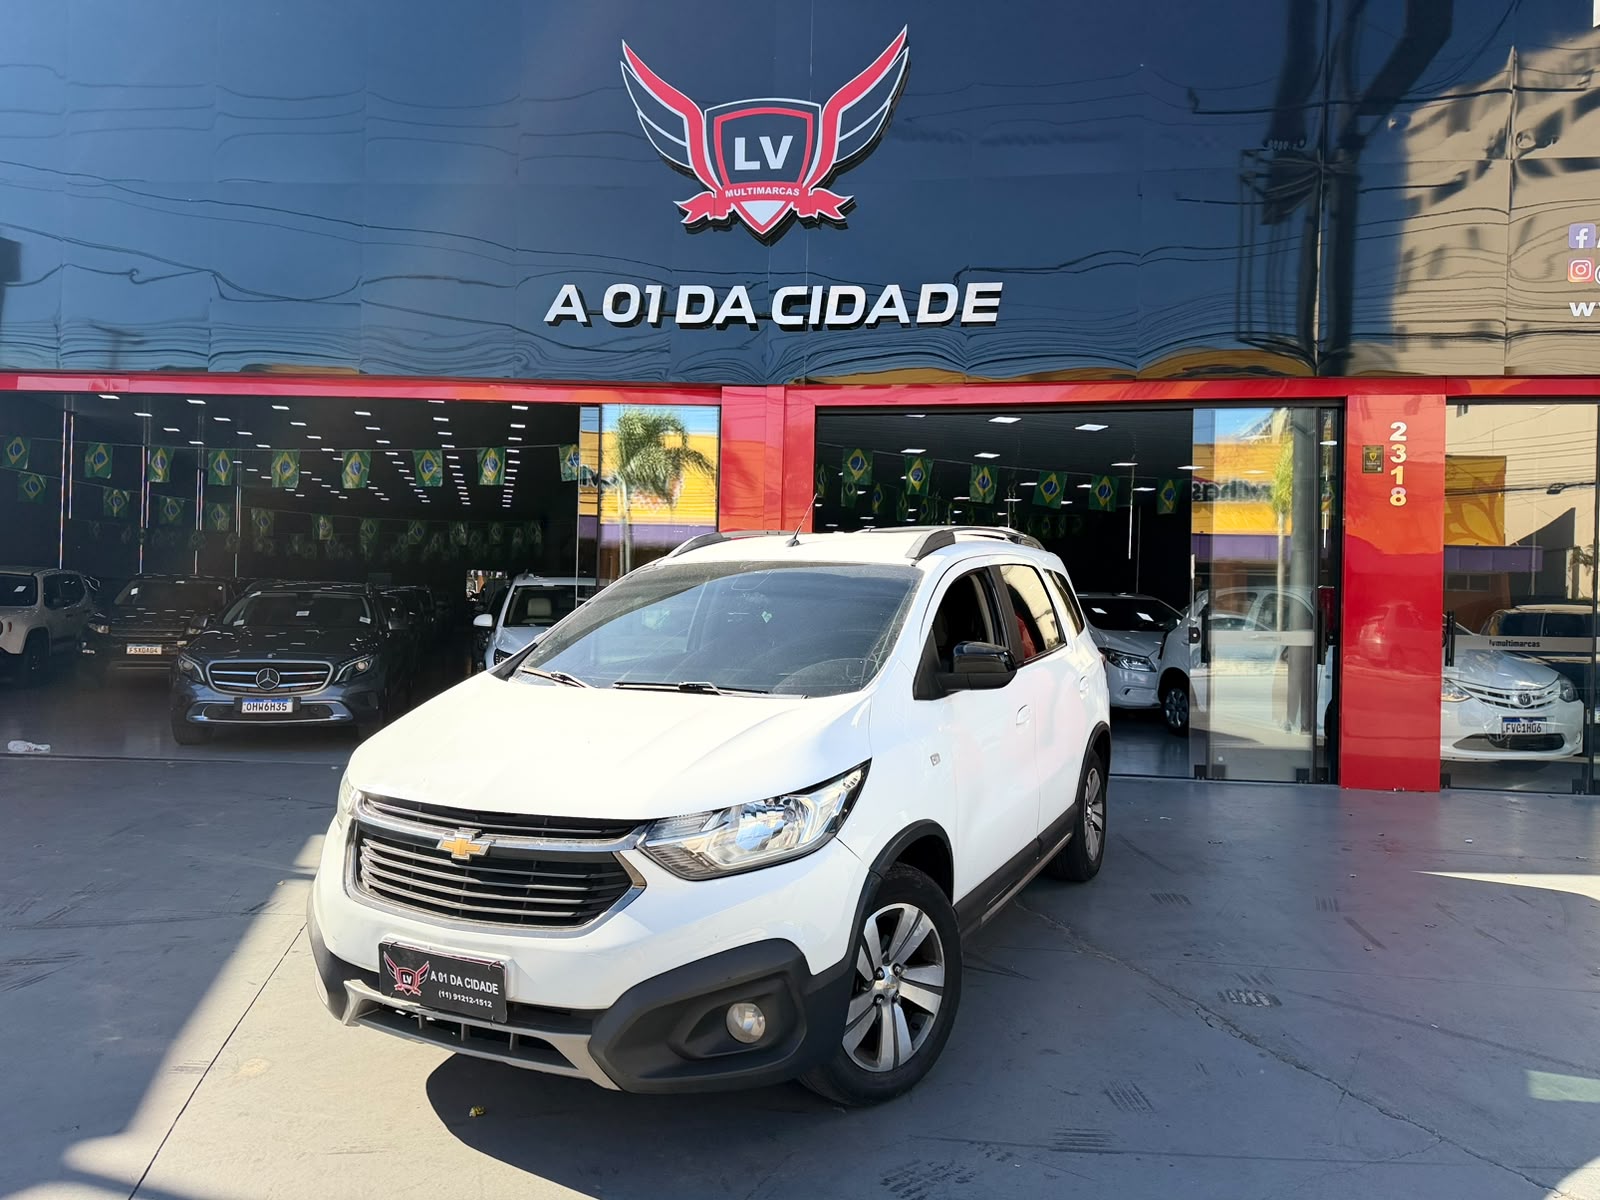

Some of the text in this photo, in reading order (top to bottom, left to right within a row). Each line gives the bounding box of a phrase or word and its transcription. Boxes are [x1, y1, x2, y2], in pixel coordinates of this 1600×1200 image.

[734, 135, 794, 171] LV
[725, 186, 800, 198] MULTIMARCAS
[543, 282, 1003, 325] A 01 DA CIDADE
[402, 974, 412, 985] LV
[430, 970, 499, 995] A 01 DA CIDADE
[438, 989, 493, 1009] (11) 91212-1512
